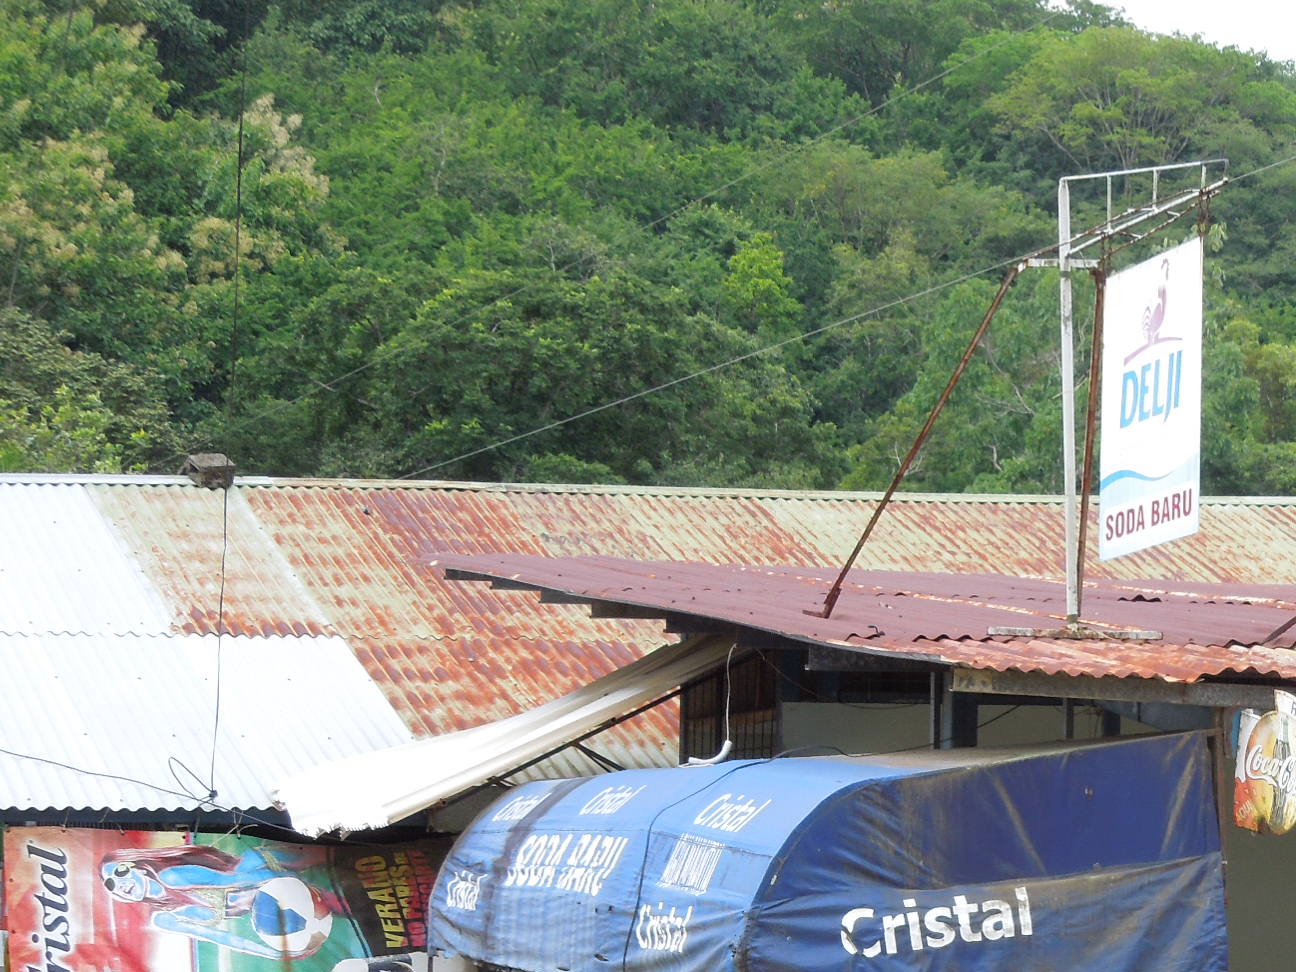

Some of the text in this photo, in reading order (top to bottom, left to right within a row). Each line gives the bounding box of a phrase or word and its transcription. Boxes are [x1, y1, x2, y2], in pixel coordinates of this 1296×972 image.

[1119, 349, 1183, 429] DELJI
[1105, 488, 1192, 541] SODA BARU
[694, 794, 772, 833] Cristal
[354, 855, 409, 948] VERANO
[841, 887, 1033, 958] Cristal
